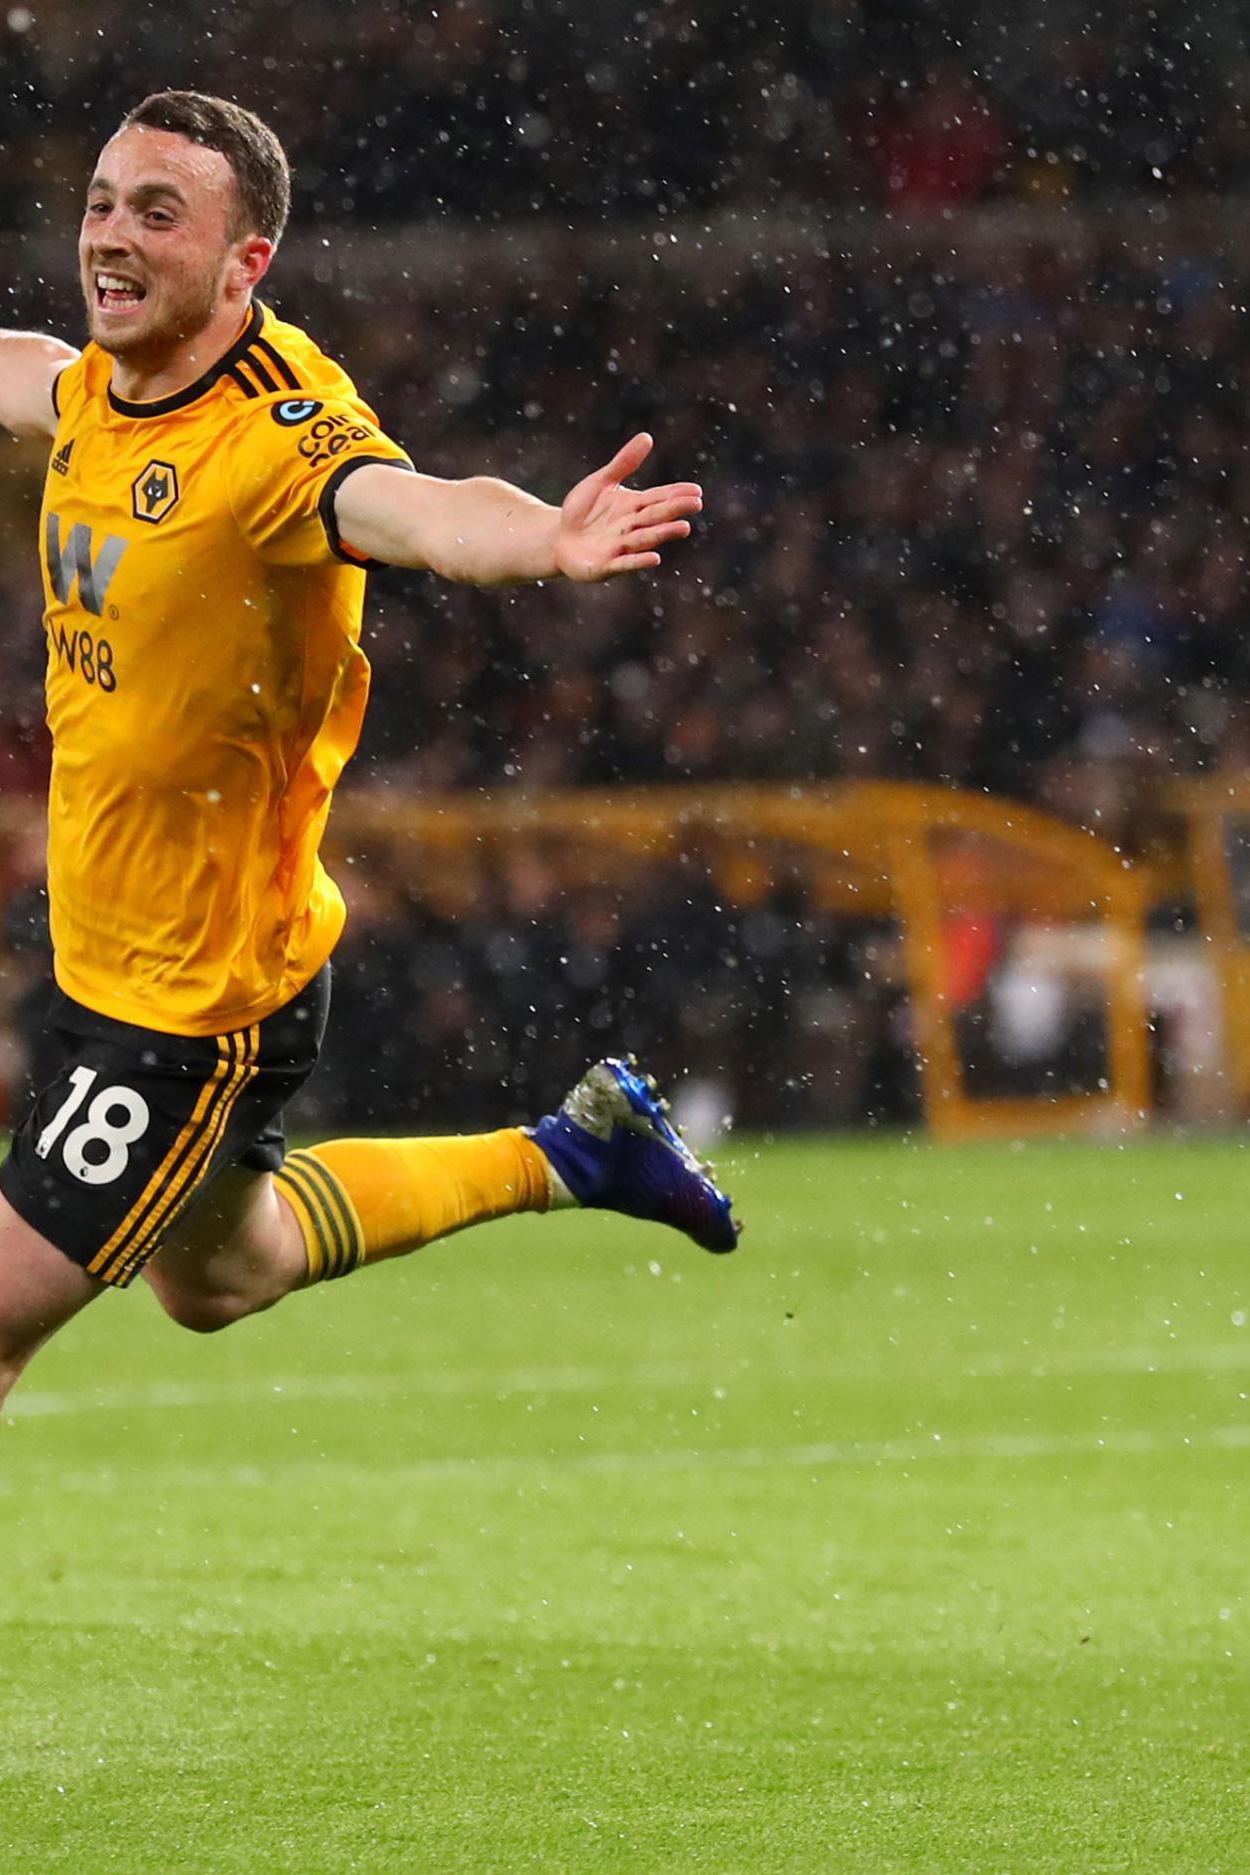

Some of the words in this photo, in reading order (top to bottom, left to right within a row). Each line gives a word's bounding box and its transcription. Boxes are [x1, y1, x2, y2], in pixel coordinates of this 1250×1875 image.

[47, 511, 129, 617] W
[49, 617, 117, 693] W88
[35, 1065, 150, 1185] 18
